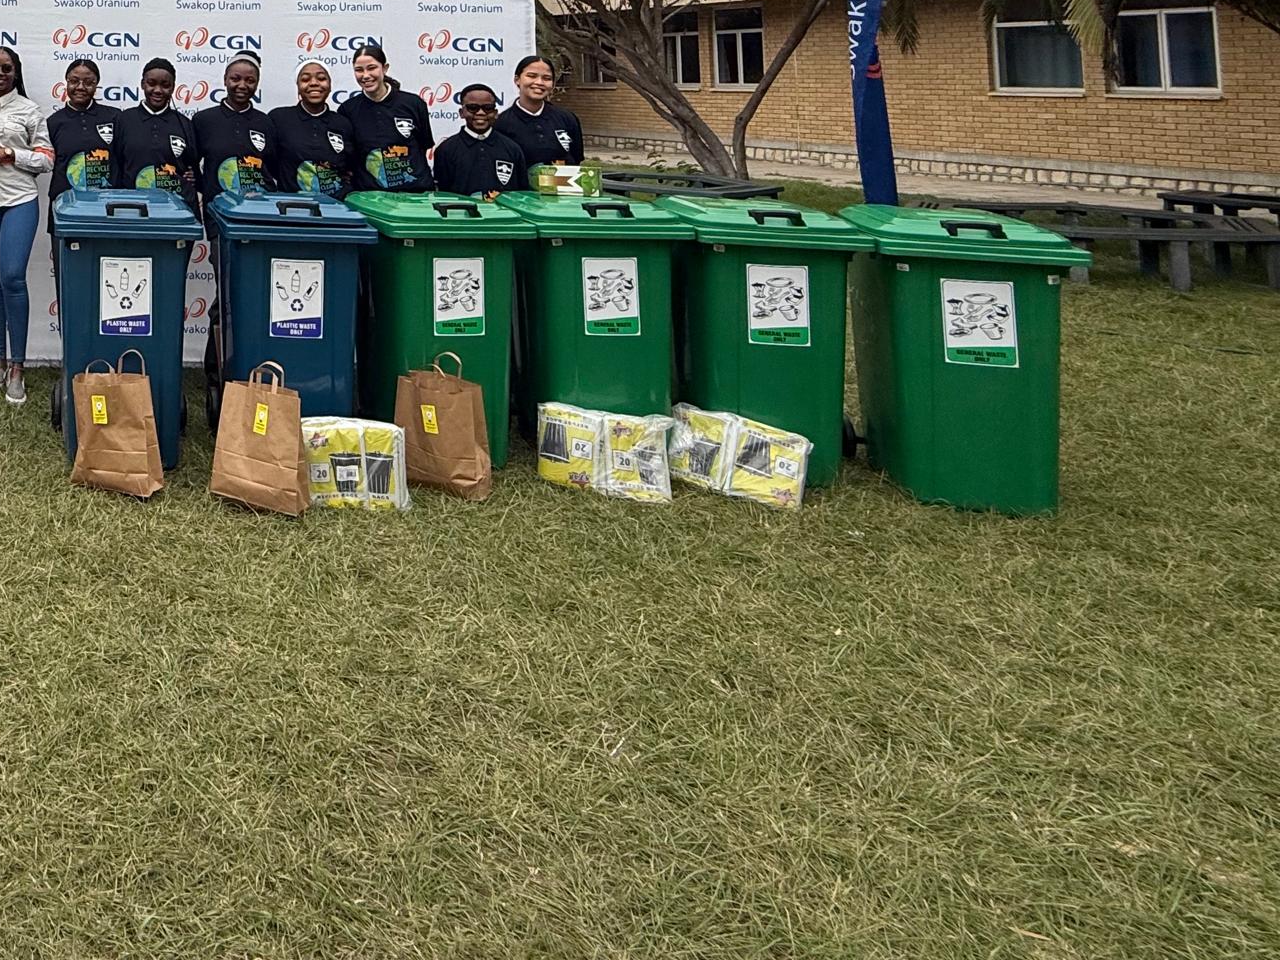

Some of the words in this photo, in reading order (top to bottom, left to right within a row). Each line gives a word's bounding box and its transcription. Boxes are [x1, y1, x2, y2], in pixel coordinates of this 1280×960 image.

[176, 0, 215, 12] Swakop
[218, 1, 261, 10] Uranium
[297, 2, 336, 13] Swakop
[339, 2, 382, 11] Uranium
[418, 2, 457, 14] Swakop
[459, 3, 503, 13] Uranium
[87, 32, 139, 47] CGN
[210, 35, 262, 50] CGN
[452, 38, 503, 53] CGN
[53, 51, 93, 61] Swakop
[96, 51, 140, 61] Uranium
[176, 53, 216, 64] Swakop
[419, 55, 458, 67] Swakop
[461, 56, 504, 66] Uranium
[428, 109, 459, 120] wakop
[86, 165, 110, 173] RECYCLE
[385, 160, 410, 170] RECYCLE
[156, 179, 181, 187] RECYCLE
[956, 349, 984, 357] GENERAL
[574, 442, 586, 453] 20
[619, 457, 631, 466] 20
[779, 461, 792, 471] 20
[316, 469, 327, 479] 20
